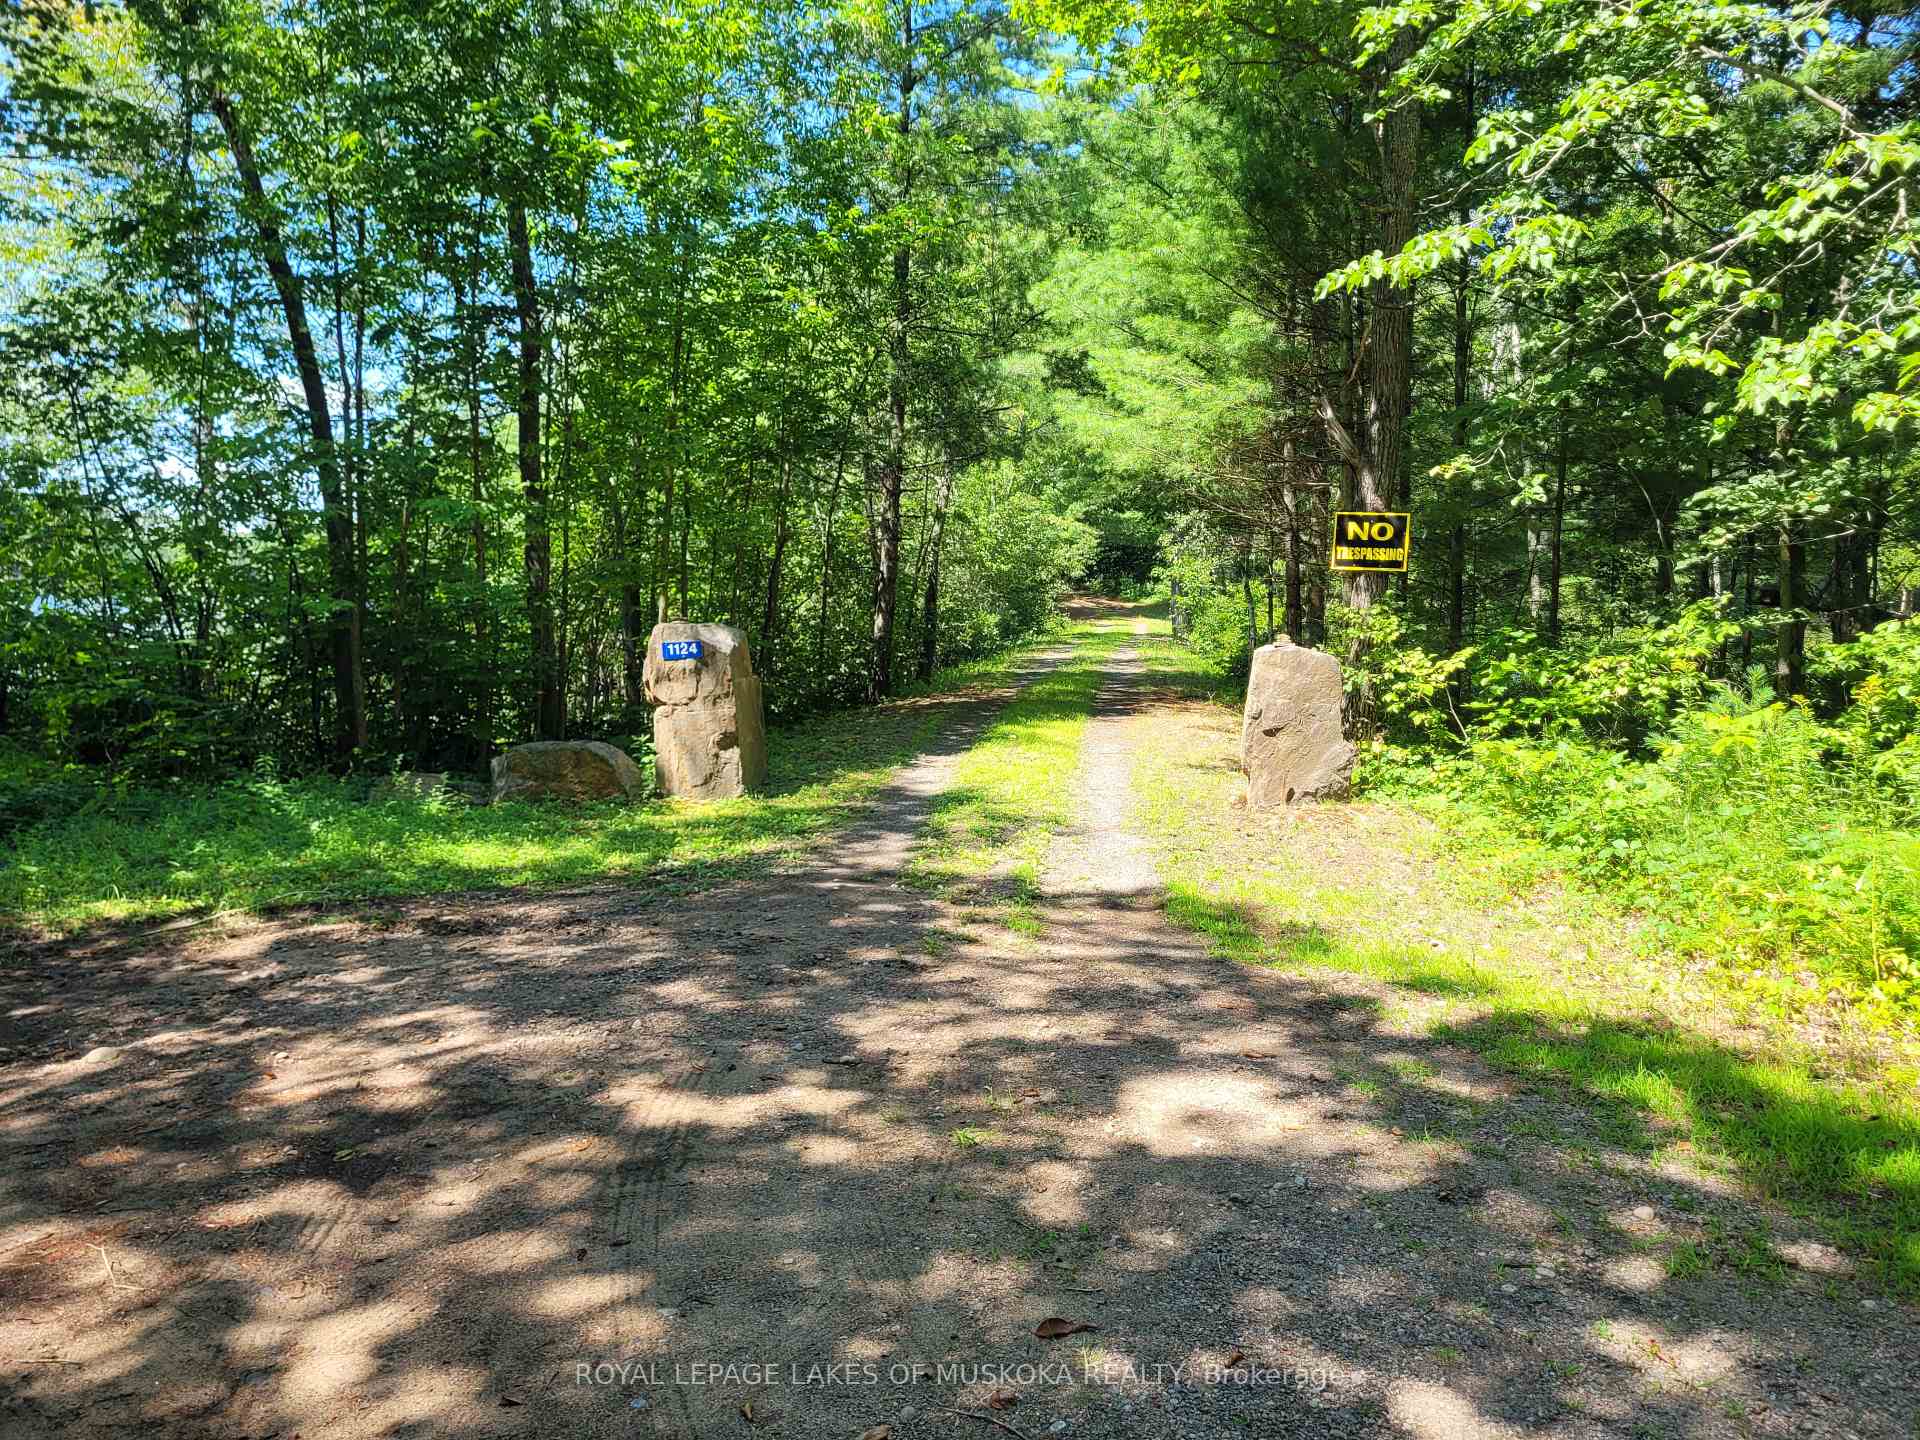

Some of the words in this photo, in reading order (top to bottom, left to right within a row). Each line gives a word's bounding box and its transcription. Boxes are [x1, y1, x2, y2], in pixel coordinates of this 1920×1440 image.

[1347, 521, 1394, 541] NO
[1336, 546, 1404, 560] TRESPASSING
[667, 642, 698, 655] 1124
